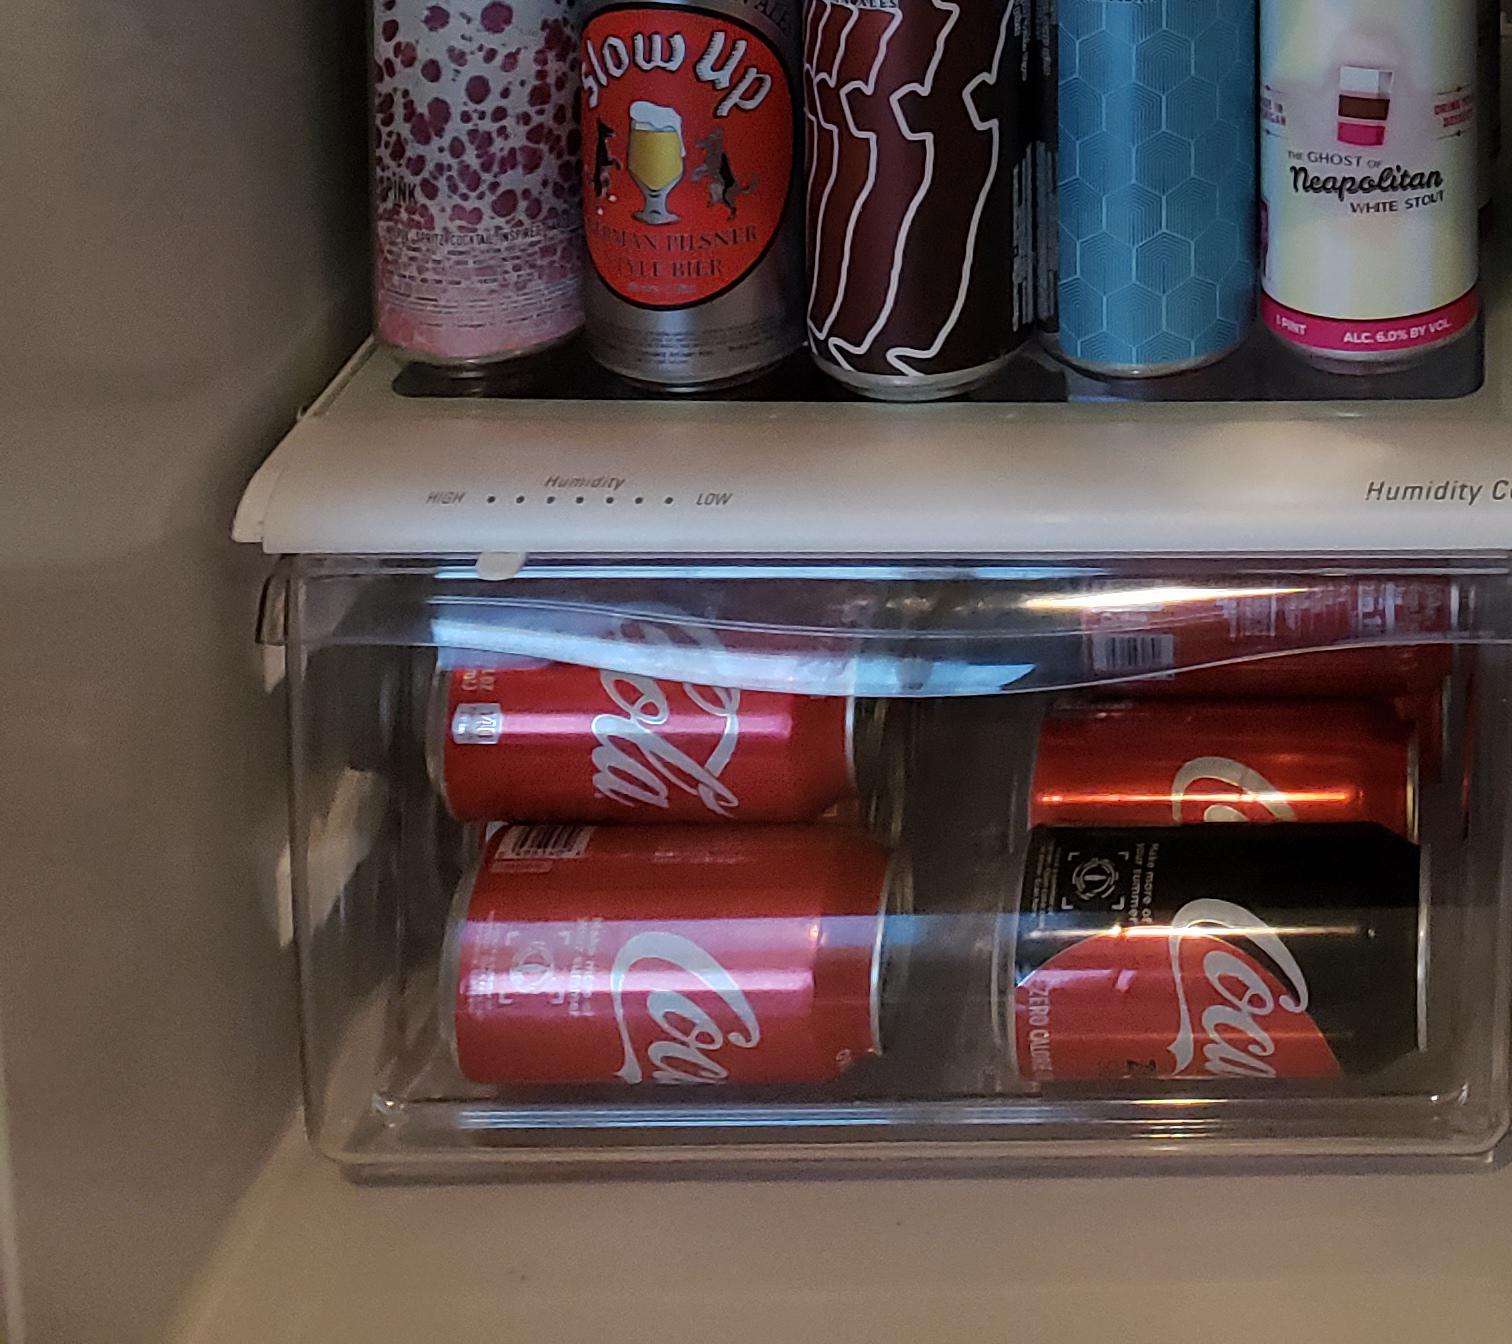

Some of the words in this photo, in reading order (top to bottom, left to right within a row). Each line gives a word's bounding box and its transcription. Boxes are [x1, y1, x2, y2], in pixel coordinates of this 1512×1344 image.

[1307, 150, 1363, 169] GHOST
[1289, 164, 1443, 202] Neapolitan
[1349, 198, 1398, 214] WHITE
[1404, 190, 1445, 211] STOUT
[666, 225, 757, 252] PILSNER
[1410, 324, 1426, 340] BY
[544, 474, 626, 491] Humidity
[1365, 480, 1483, 506] Humidity
[696, 492, 733, 506] LOW
